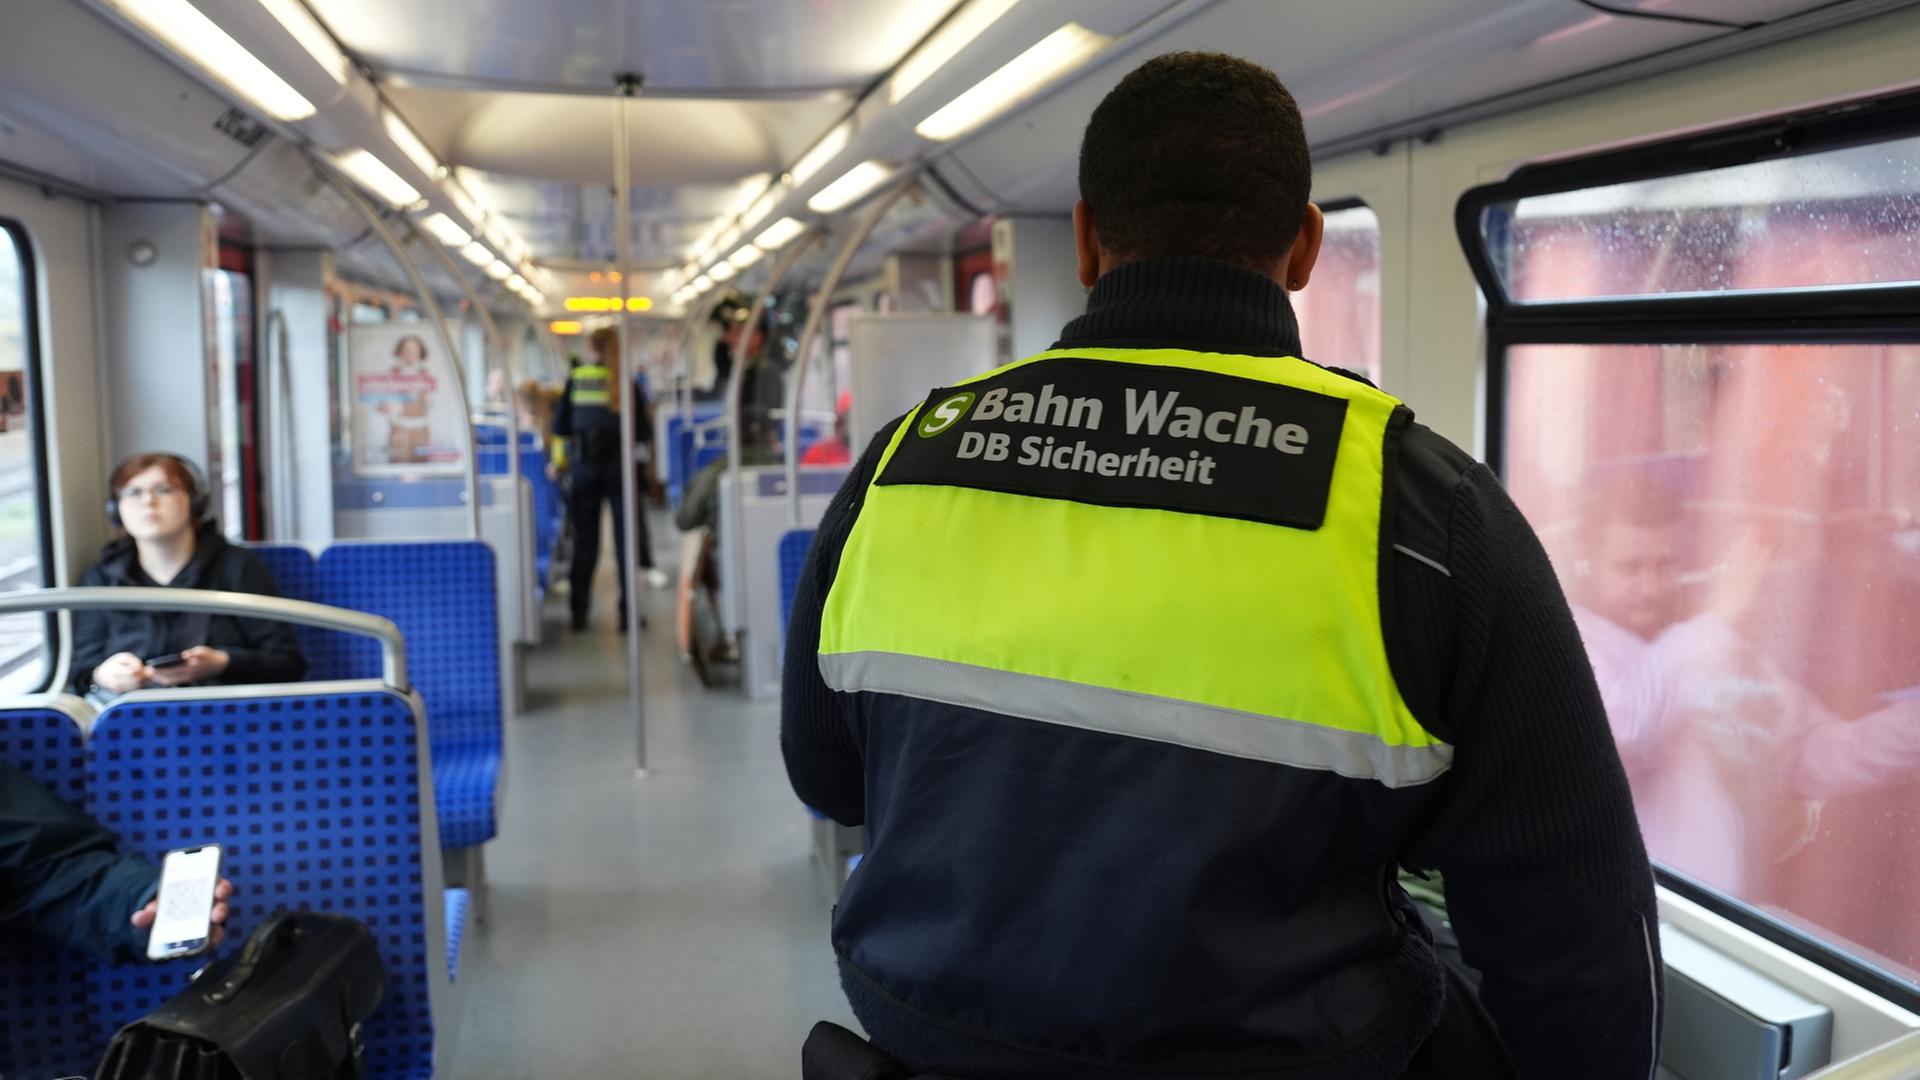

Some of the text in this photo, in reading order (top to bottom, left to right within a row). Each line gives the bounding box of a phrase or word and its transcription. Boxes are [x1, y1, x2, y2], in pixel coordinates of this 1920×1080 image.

[923, 383, 1309, 455] S Bahn Wache
[956, 431, 1217, 485] DB Sicherheit
